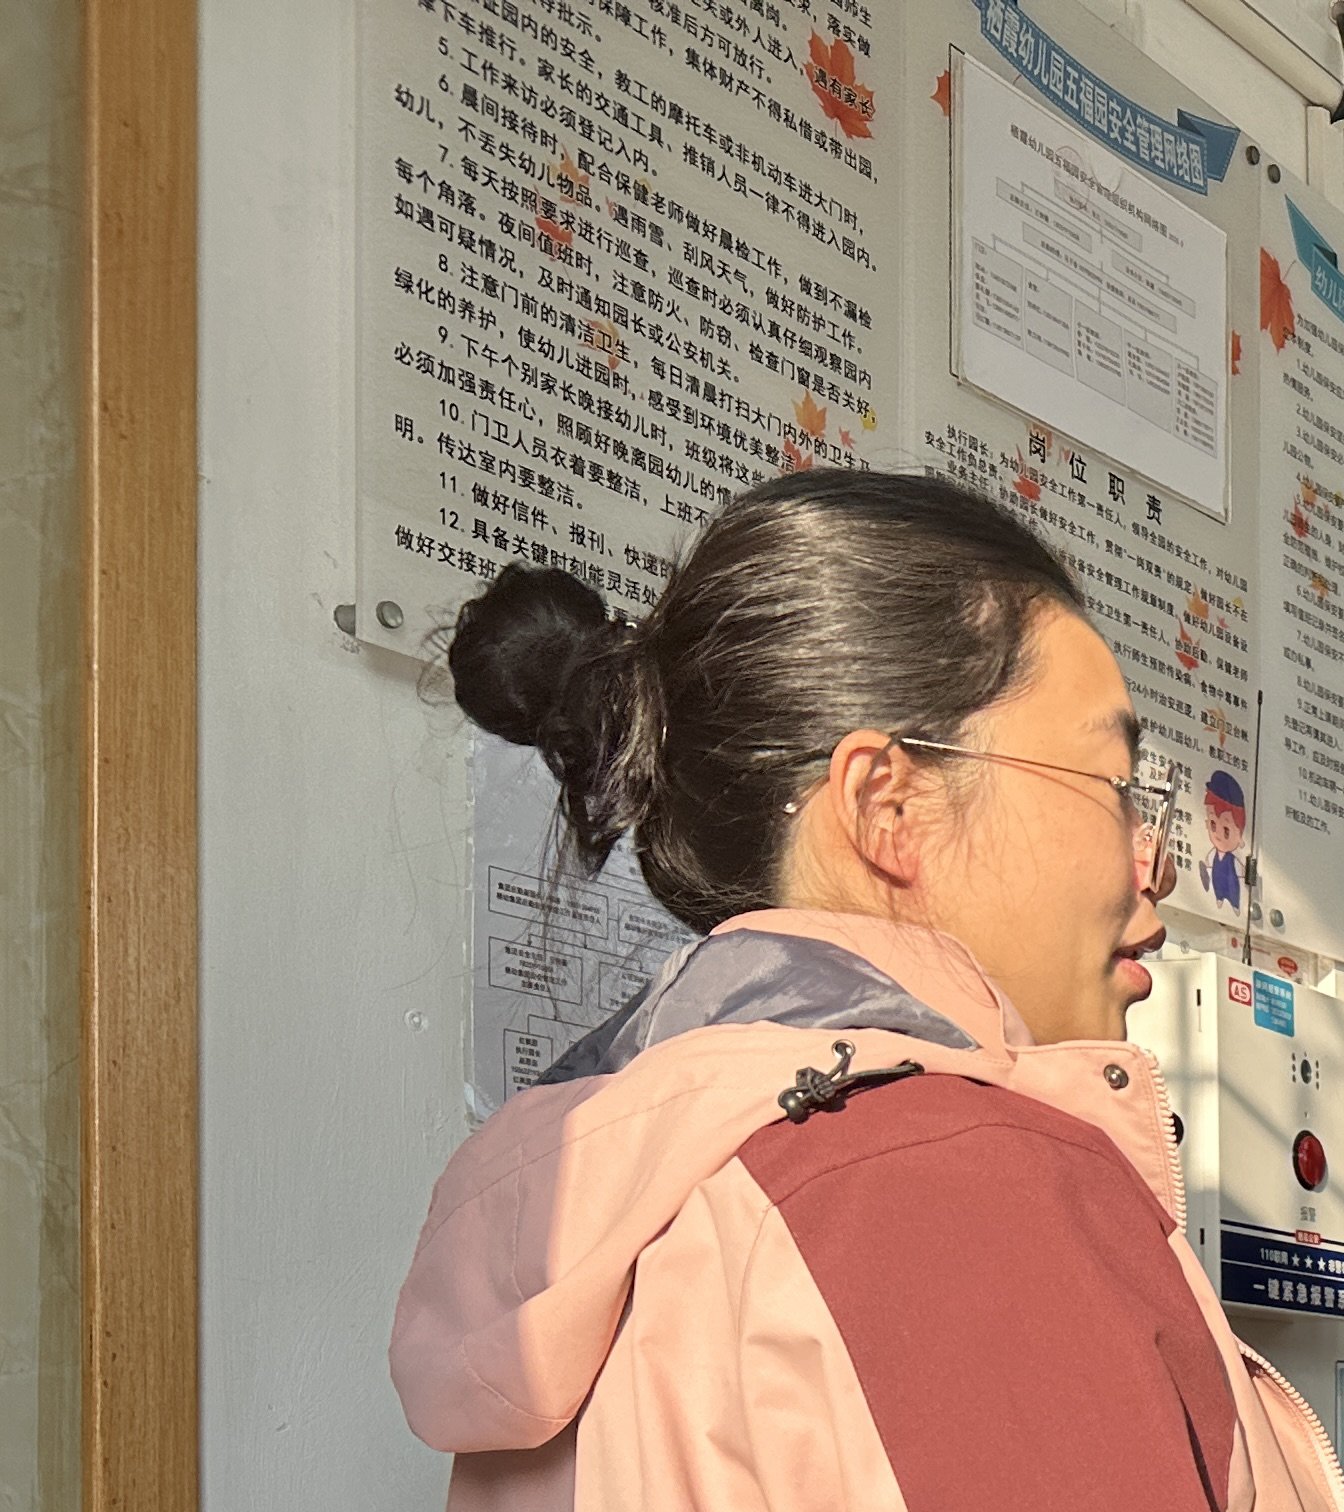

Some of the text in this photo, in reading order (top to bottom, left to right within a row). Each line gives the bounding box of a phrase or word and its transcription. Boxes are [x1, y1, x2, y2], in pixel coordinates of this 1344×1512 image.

[588, 0, 878, 185] 保障工作，集体财产不得私借或带出园，
[741, 0, 788, 31] 离岗。
[470, 0, 865, 235] 证园内的安全，教工的摩托车或非机动车进大门时，
[394, 344, 739, 507] 必须加强责任心，照顾好晚离园幼儿的情
[438, 326, 771, 487] 9.下午个别家长晚接幼儿时，班级将这些
[394, 524, 504, 581] 做好交接班
[439, 508, 662, 608] 12.具备关键时刻能灵活处
